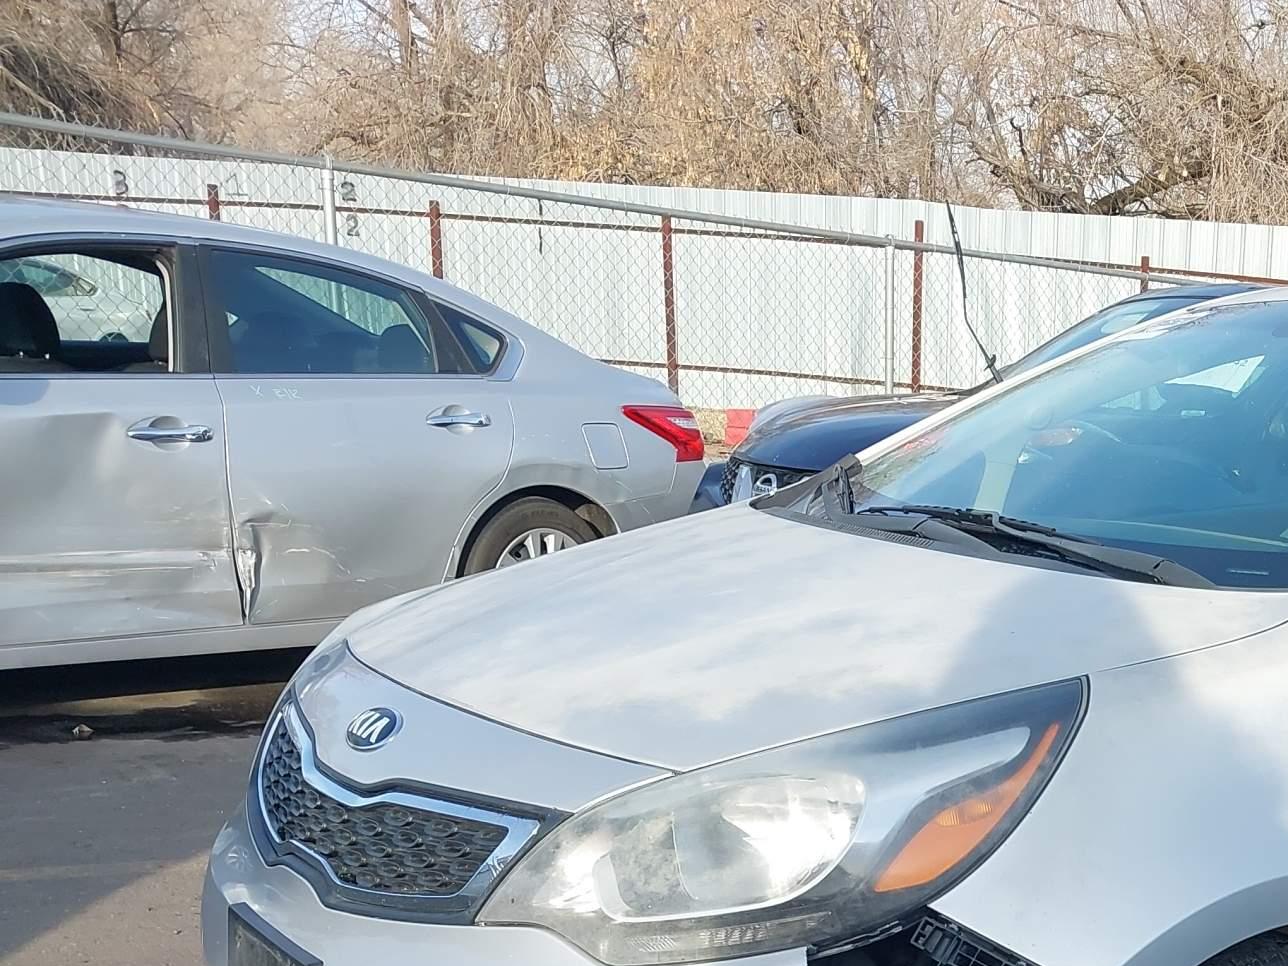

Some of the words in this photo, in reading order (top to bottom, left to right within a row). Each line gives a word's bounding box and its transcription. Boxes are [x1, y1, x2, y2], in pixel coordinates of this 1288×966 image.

[113, 169, 129, 196] 3
[345, 214, 360, 237] 2
[347, 710, 391, 744] KIA
